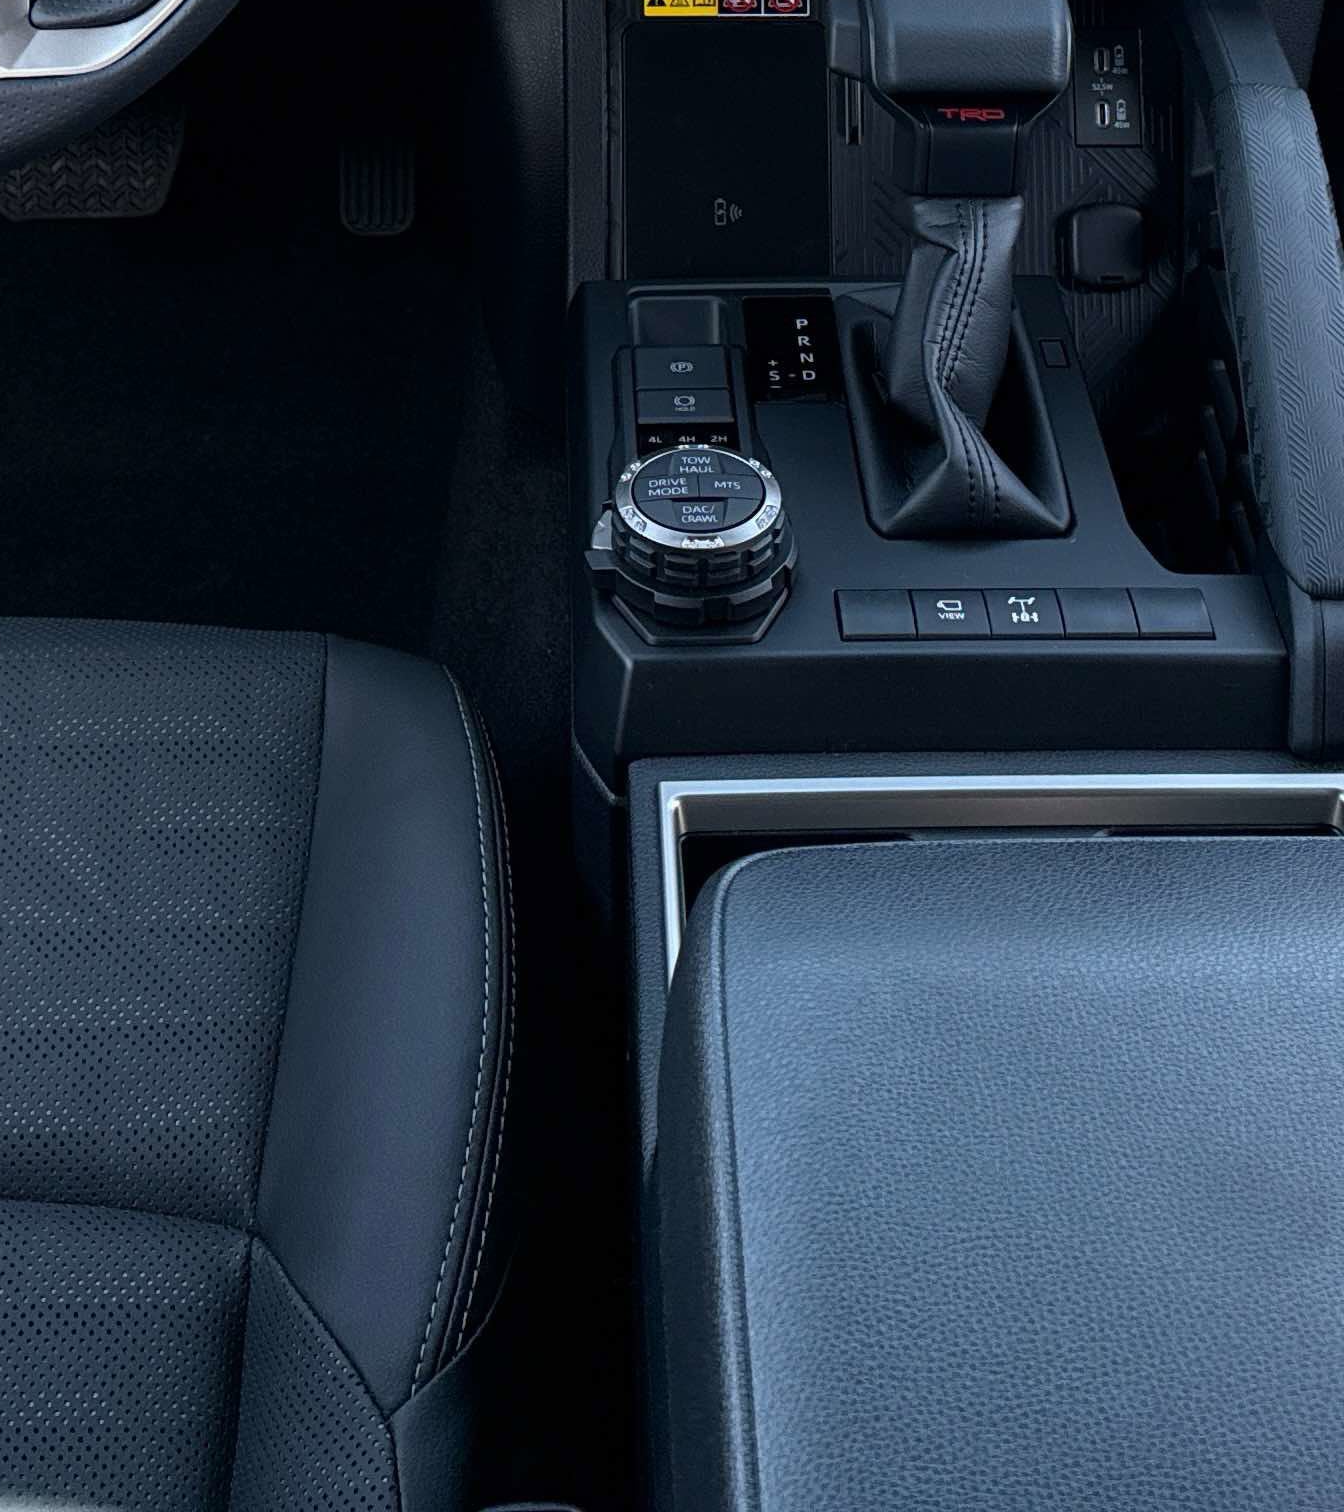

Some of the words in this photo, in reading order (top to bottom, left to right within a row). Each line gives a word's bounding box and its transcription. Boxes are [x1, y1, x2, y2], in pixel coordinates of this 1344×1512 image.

[937, 107, 1005, 122] TRD
[795, 319, 808, 330] P
[797, 335, 811, 347] R
[800, 352, 814, 364] N
[768, 370, 781, 381] S
[802, 370, 816, 381] D
[648, 435, 663, 444] 4L
[678, 435, 696, 443] 4H
[710, 435, 728, 444] 2H
[681, 456, 711, 465] TOW
[679, 466, 715, 474] HAUL
[648, 477, 688, 488] DRIVE
[714, 481, 741, 490] MTS
[648, 487, 688, 497] MODE
[682, 504, 715, 514] DAC/
[681, 514, 718, 524] CRAWL
[938, 612, 966, 621] VIEW
